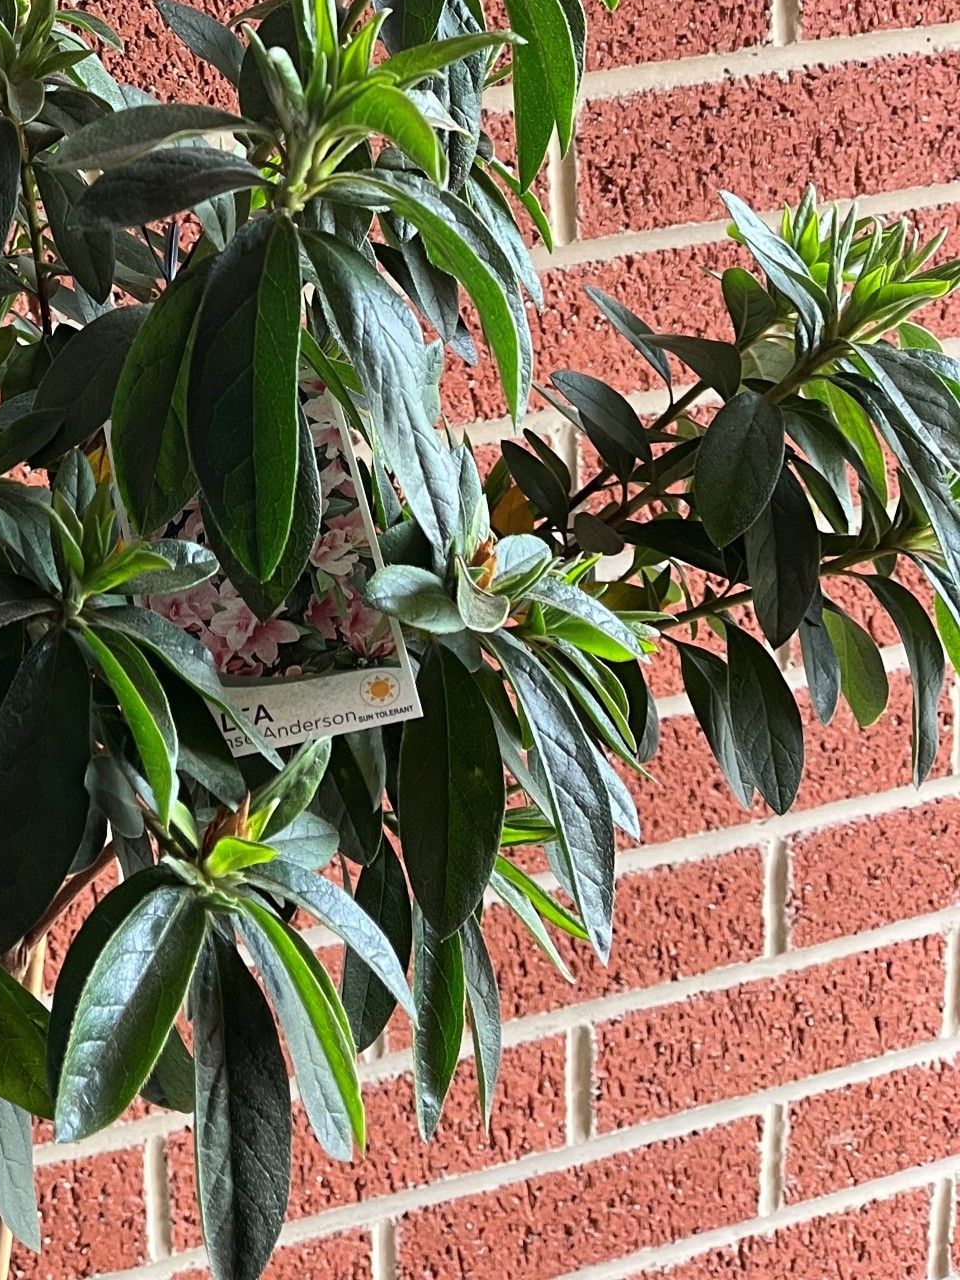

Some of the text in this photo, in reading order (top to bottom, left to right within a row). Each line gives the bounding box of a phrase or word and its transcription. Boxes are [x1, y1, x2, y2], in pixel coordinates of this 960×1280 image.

[264, 711, 357, 739] Anderson
[358, 705, 413, 723] SUN TOLERANT
